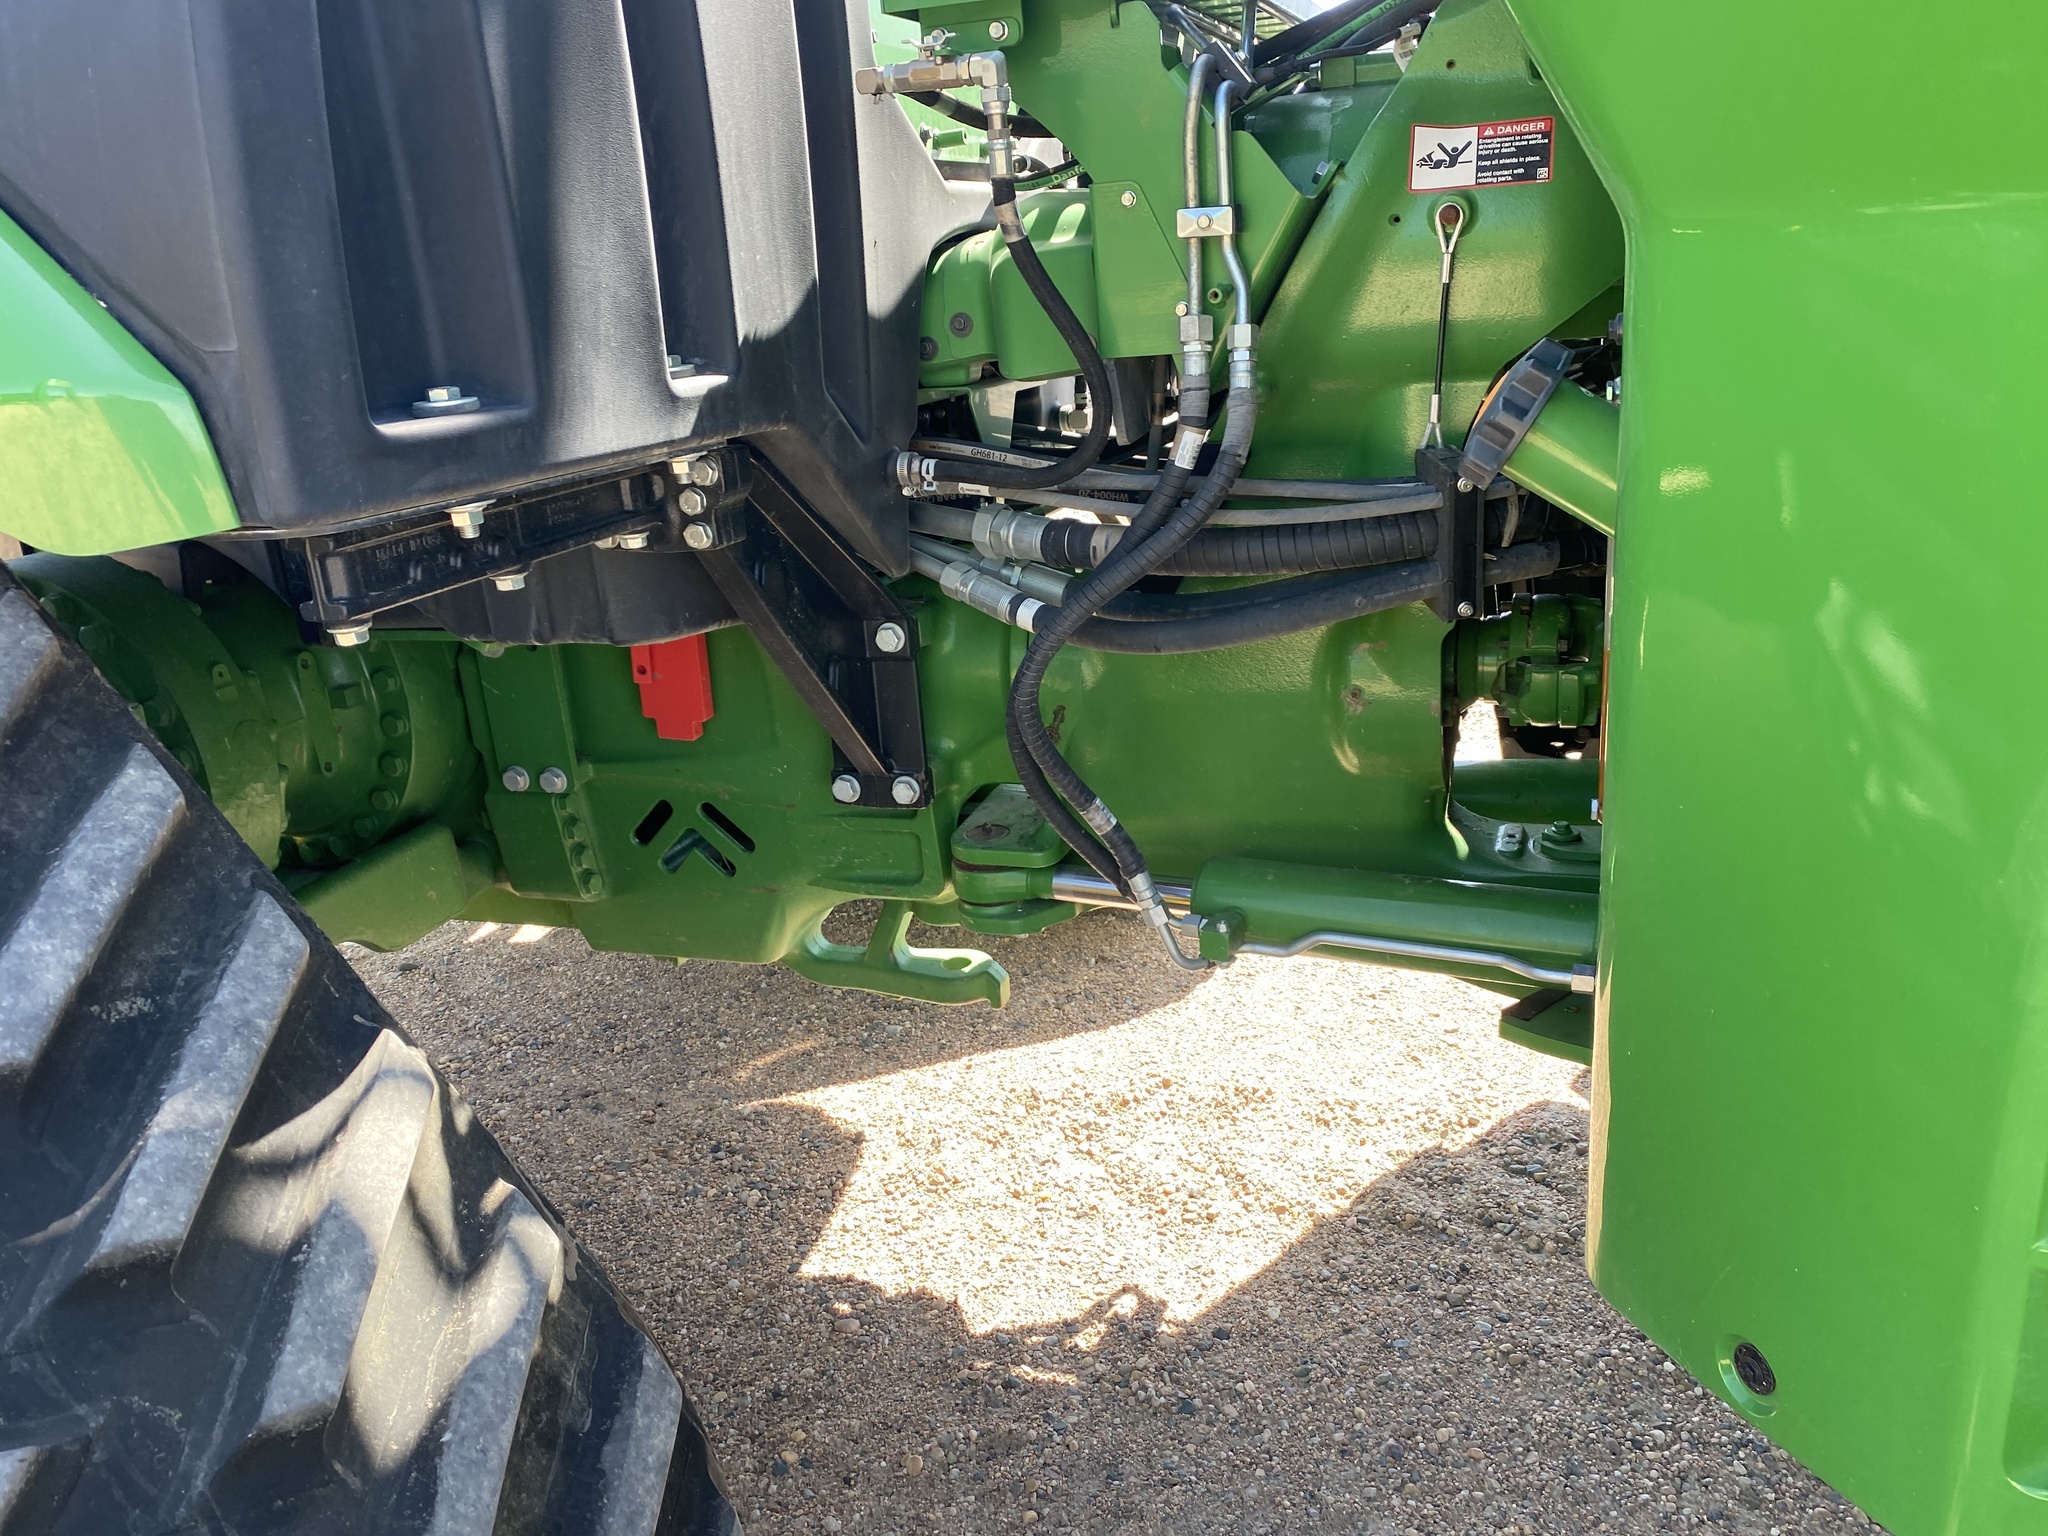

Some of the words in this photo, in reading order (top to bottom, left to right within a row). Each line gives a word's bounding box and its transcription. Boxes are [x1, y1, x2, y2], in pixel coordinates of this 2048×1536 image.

[1497, 122, 1545, 134] DANGER
[1479, 136, 1514, 144] Entanglement
[971, 447, 1007, 462] GH681-12
[1078, 488, 1129, 502] WH004-20
